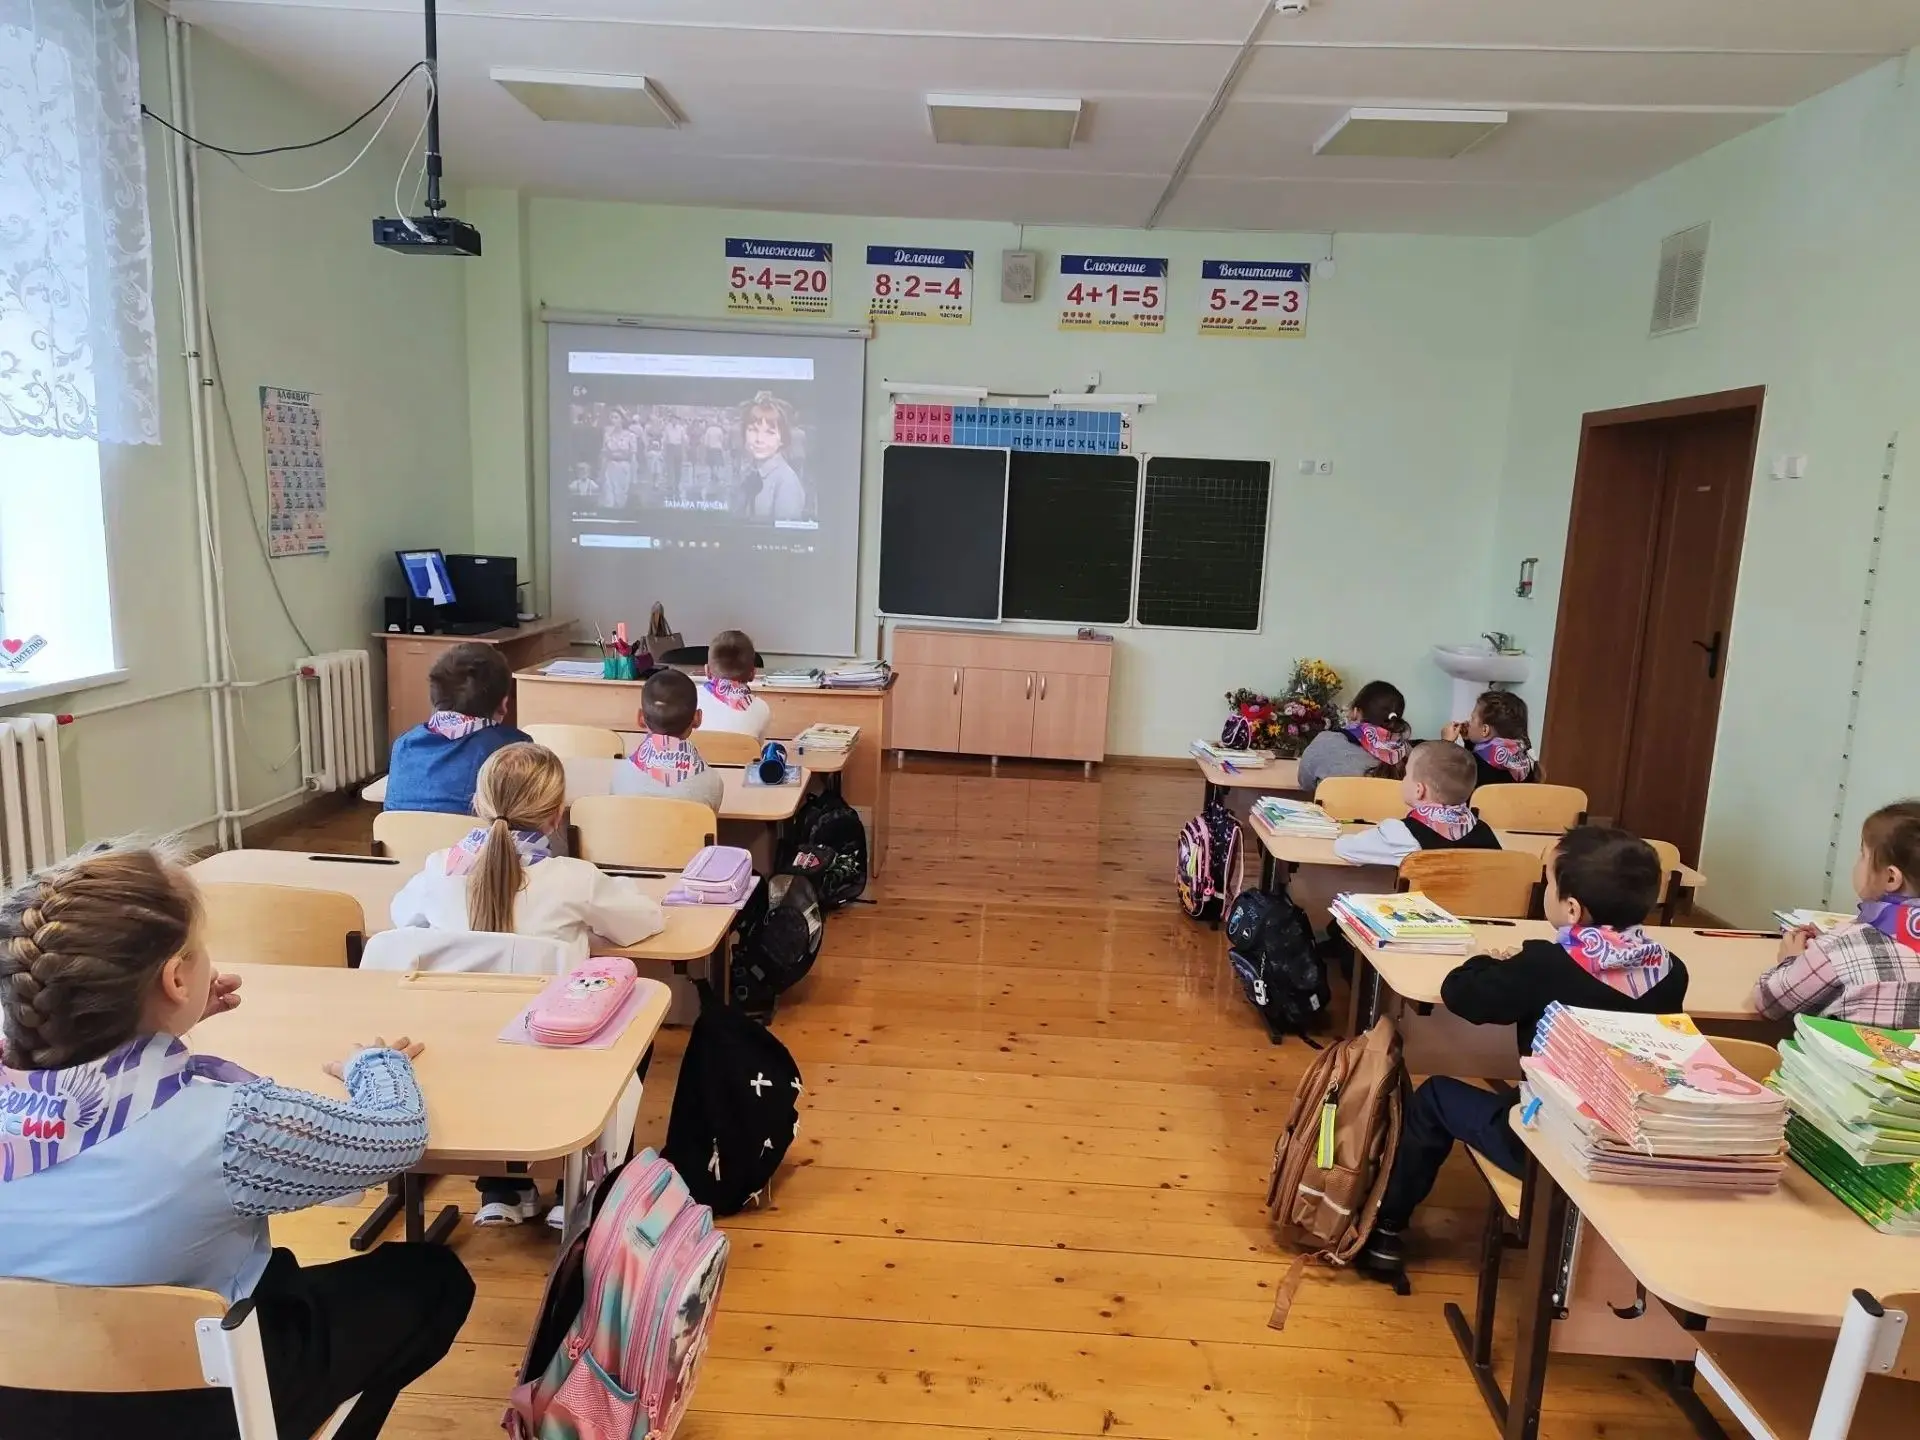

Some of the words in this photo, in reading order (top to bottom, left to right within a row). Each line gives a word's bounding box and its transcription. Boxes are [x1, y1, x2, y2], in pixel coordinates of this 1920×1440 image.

[742, 241, 816, 258] Умножение
[894, 251, 945, 265] Деление
[1083, 258, 1147, 273] Сложение
[1218, 263, 1294, 278] Вычитание
[7, 638, 44, 668] УЧИТЕЛЮ
